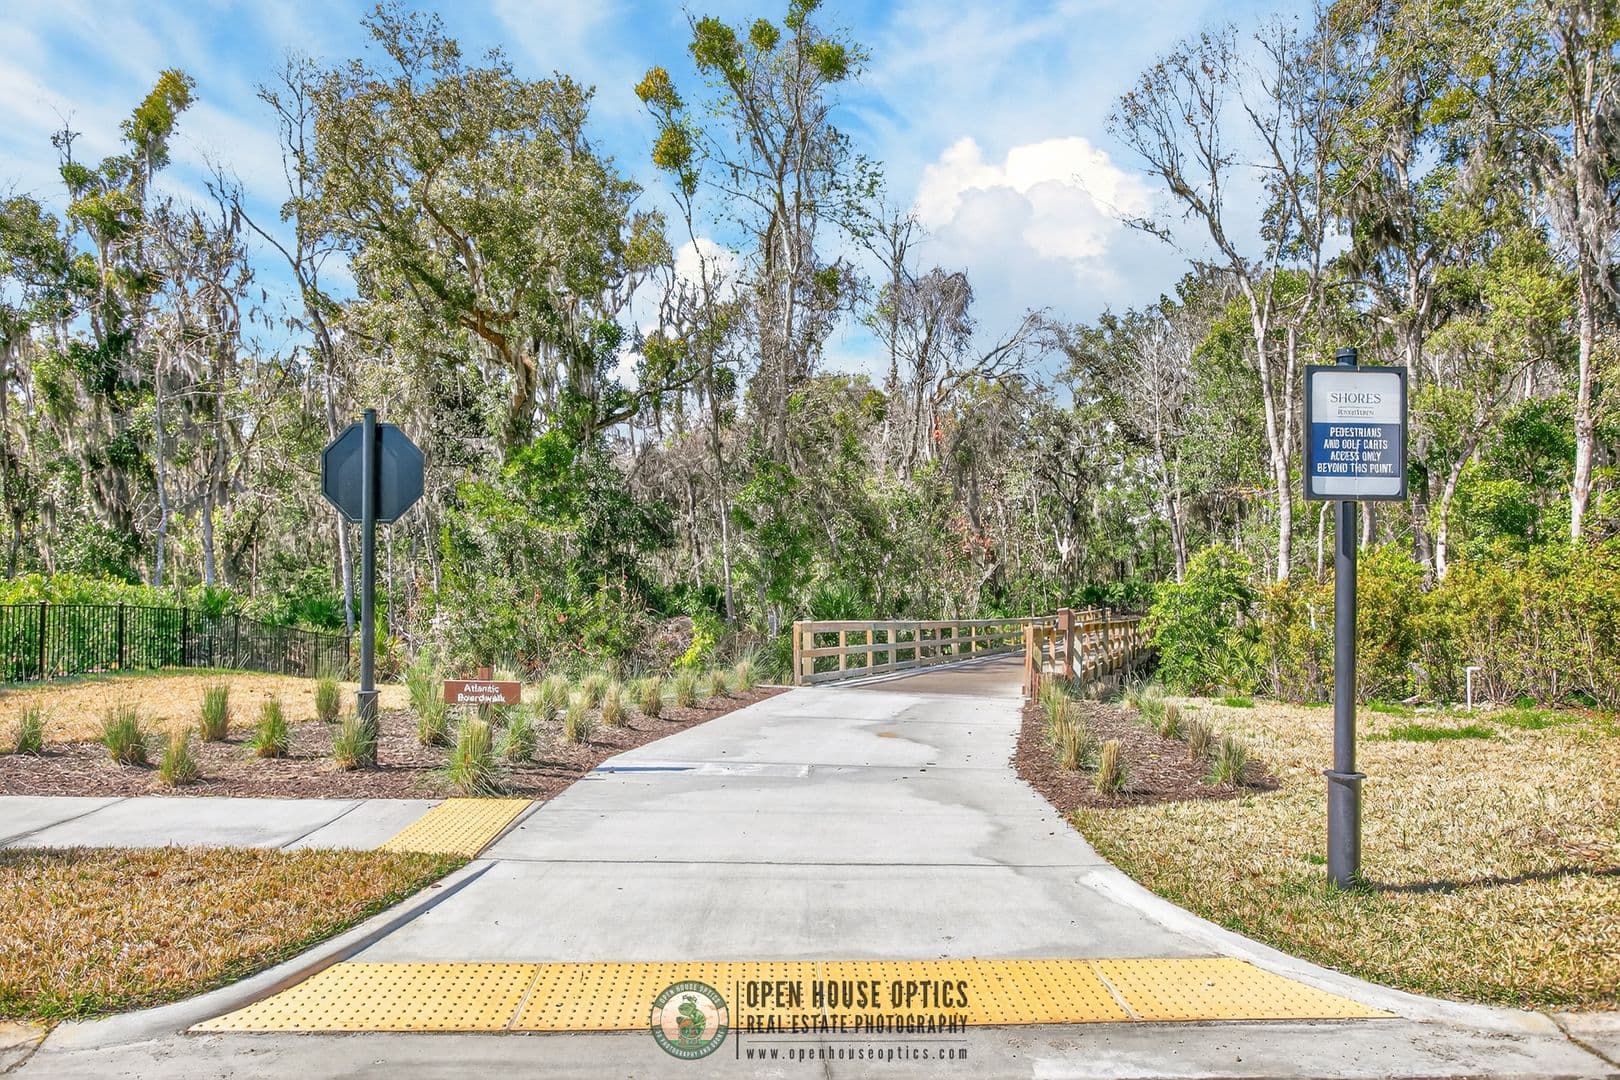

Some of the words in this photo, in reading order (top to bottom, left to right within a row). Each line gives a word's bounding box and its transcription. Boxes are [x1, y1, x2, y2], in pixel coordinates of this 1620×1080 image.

[1330, 393, 1382, 404] SHORES
[1330, 427, 1382, 437] PEDESTRIANS
[1323, 439, 1340, 449] AND
[1342, 439, 1361, 449] GOLF
[1364, 439, 1388, 449] CARTS
[1330, 451, 1359, 461] ACCESS
[1362, 451, 1382, 461] ONLY
[1317, 463, 1347, 473] BEYOND
[1350, 463, 1368, 473] THIS
[1370, 463, 1394, 473] POINT.
[464, 684, 500, 693] Atlantic
[458, 693, 505, 702] Boardwalk
